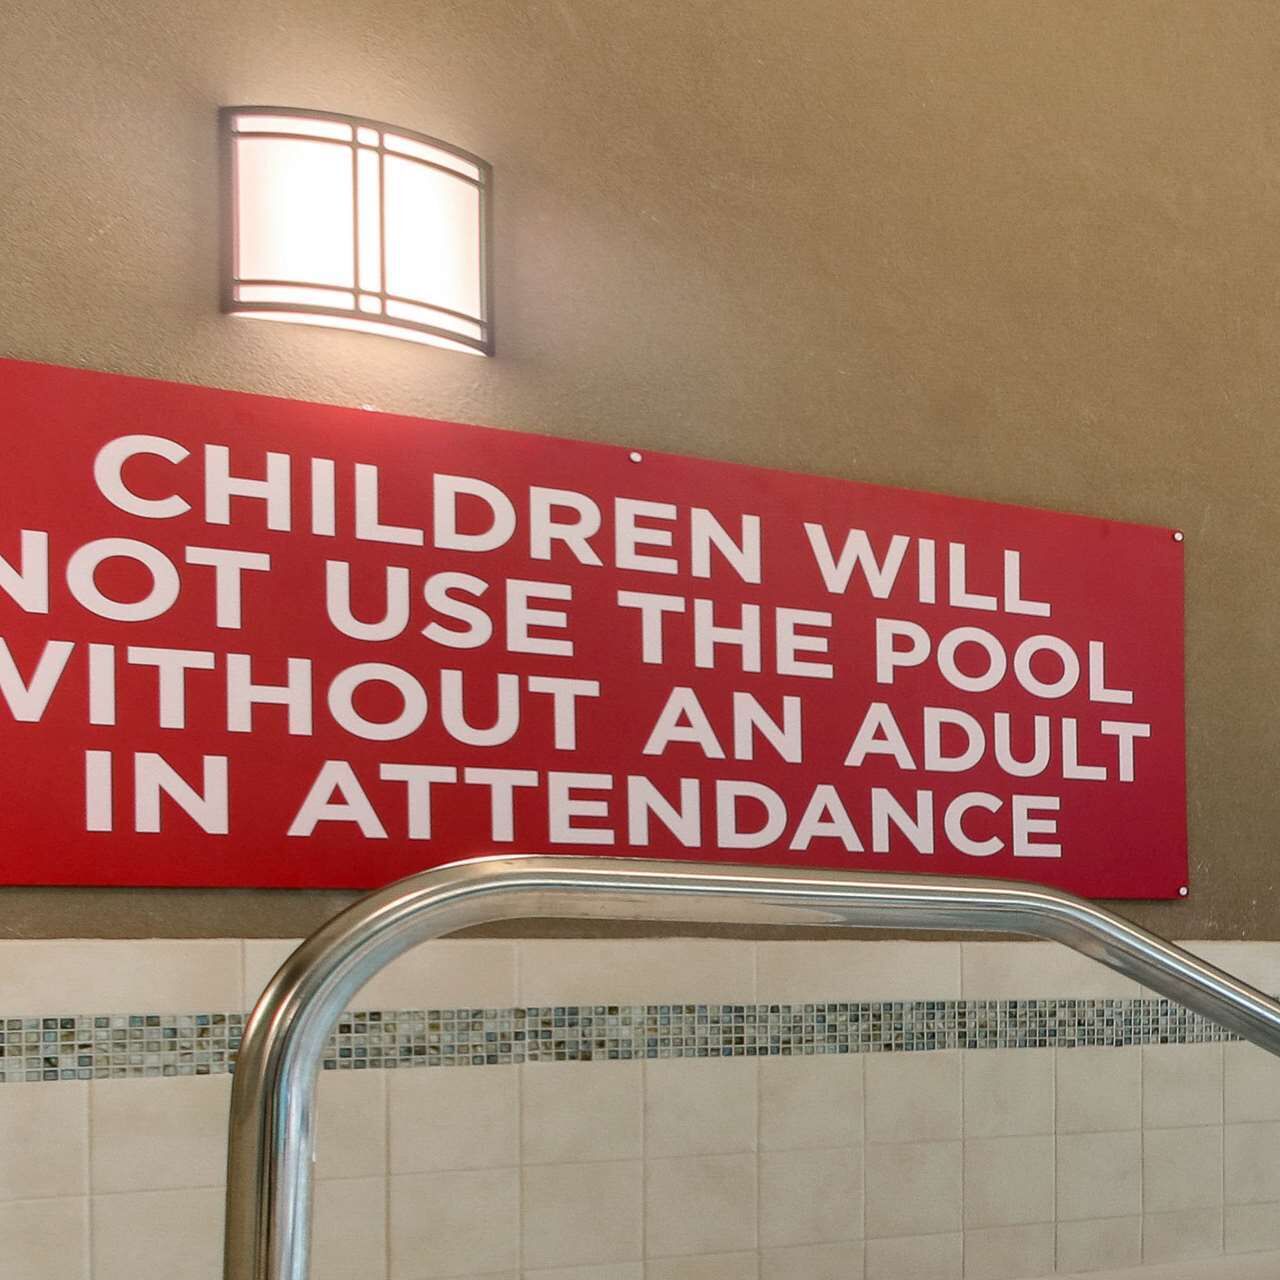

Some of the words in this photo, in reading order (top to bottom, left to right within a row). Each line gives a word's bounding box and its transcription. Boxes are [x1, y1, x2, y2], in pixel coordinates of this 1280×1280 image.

[92, 433, 761, 585] CHILDREN
[803, 521, 1051, 618] WILL
[325, 561, 574, 657] USE
[617, 590, 834, 680] THE
[875, 620, 1134, 706] POOL
[642, 687, 803, 764] AN
[842, 702, 1151, 783] ADULT
[85, 749, 228, 835] IN
[286, 758, 1062, 859] ATTENDANCE
